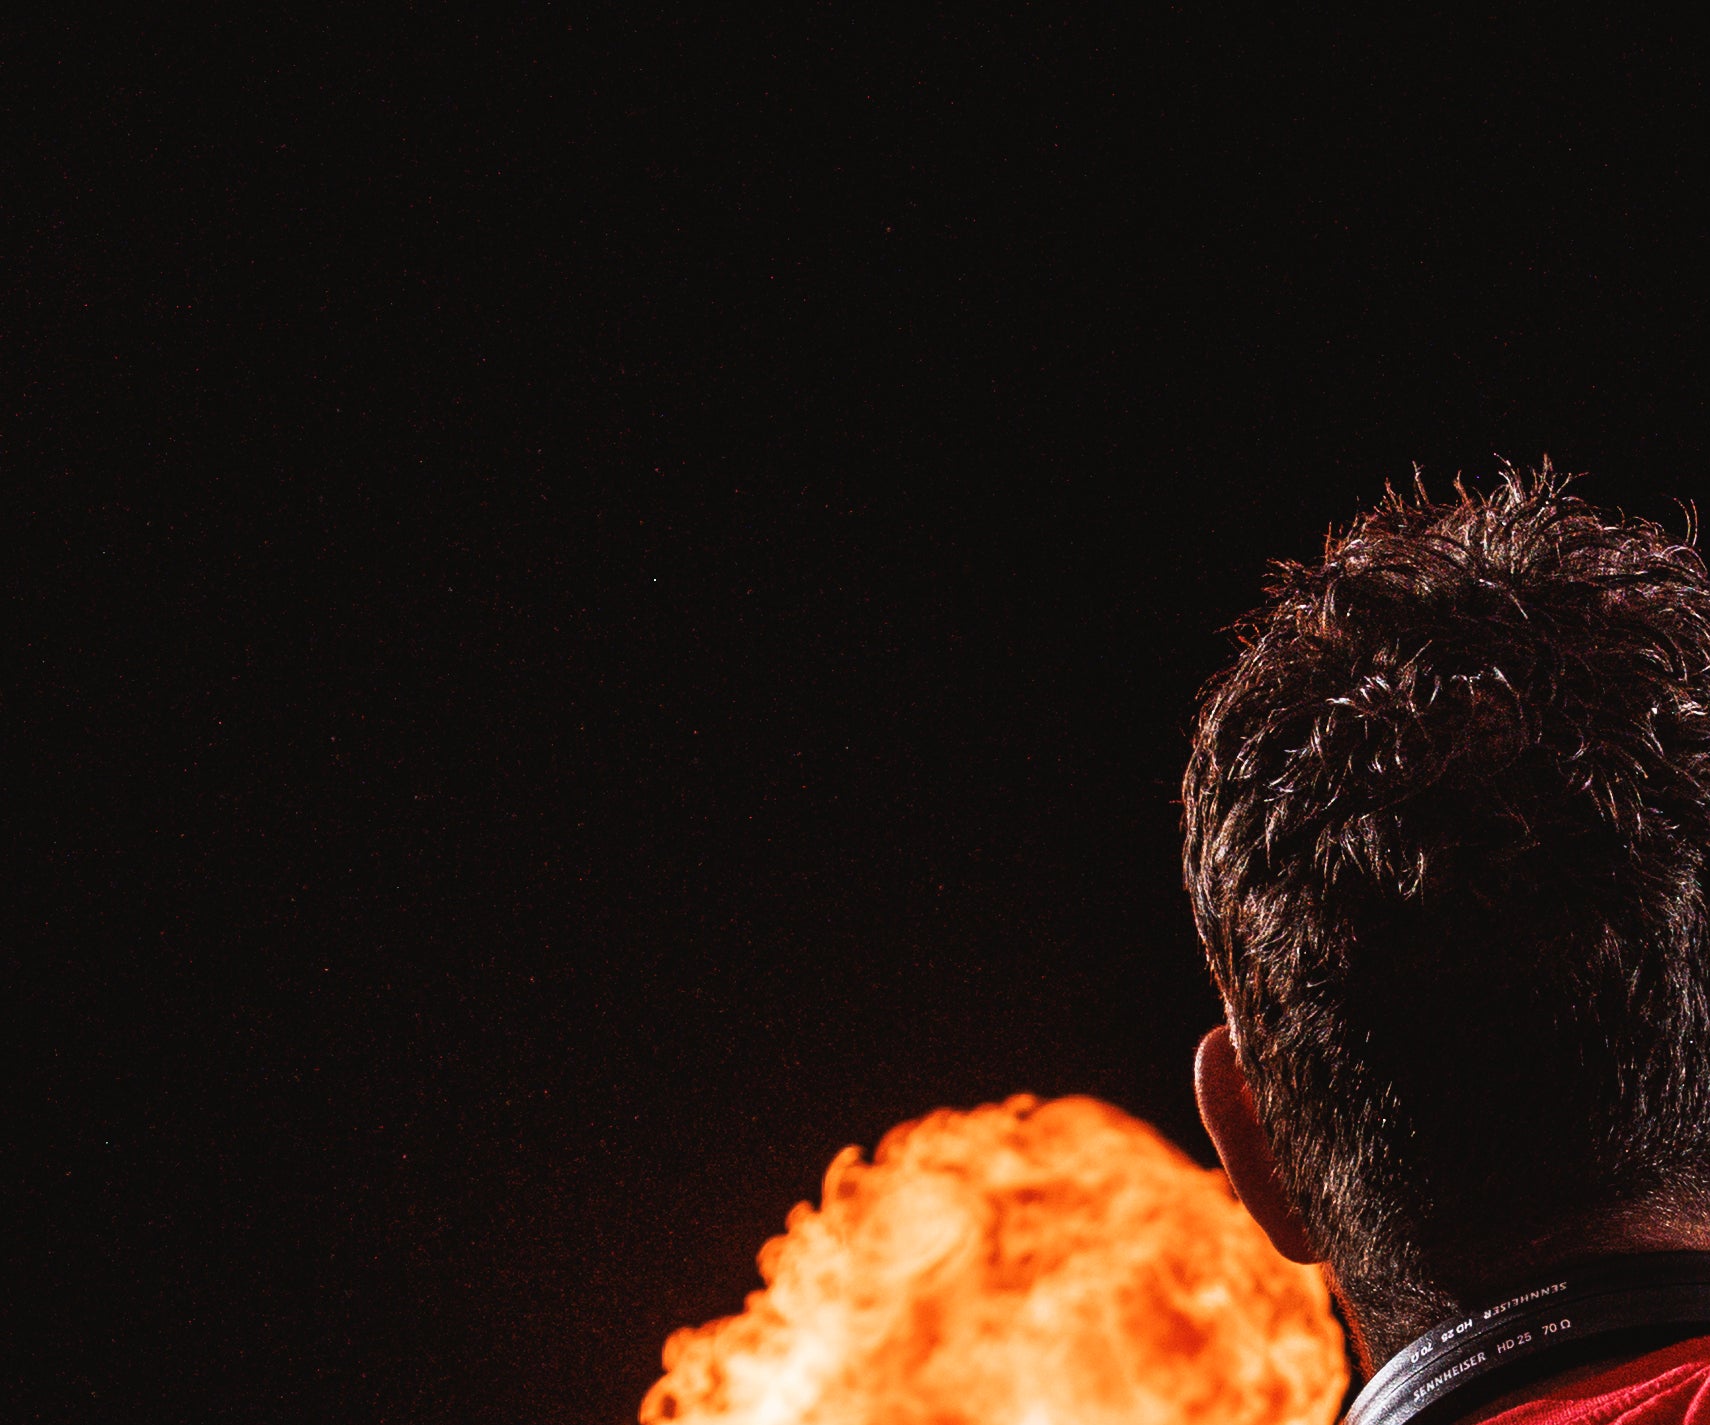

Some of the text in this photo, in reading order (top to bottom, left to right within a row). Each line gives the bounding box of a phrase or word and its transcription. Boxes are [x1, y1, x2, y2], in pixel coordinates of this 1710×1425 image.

[1483, 1281, 1567, 1320] SENNHEISER
[1441, 1328, 1455, 1343] 25
[1456, 1318, 1473, 1334] HD
[1413, 1351, 1486, 1403] SENNHEISER
[1496, 1339, 1515, 1354] HD
[1517, 1331, 1532, 1345] 25
[1541, 1322, 1557, 1336] 70
